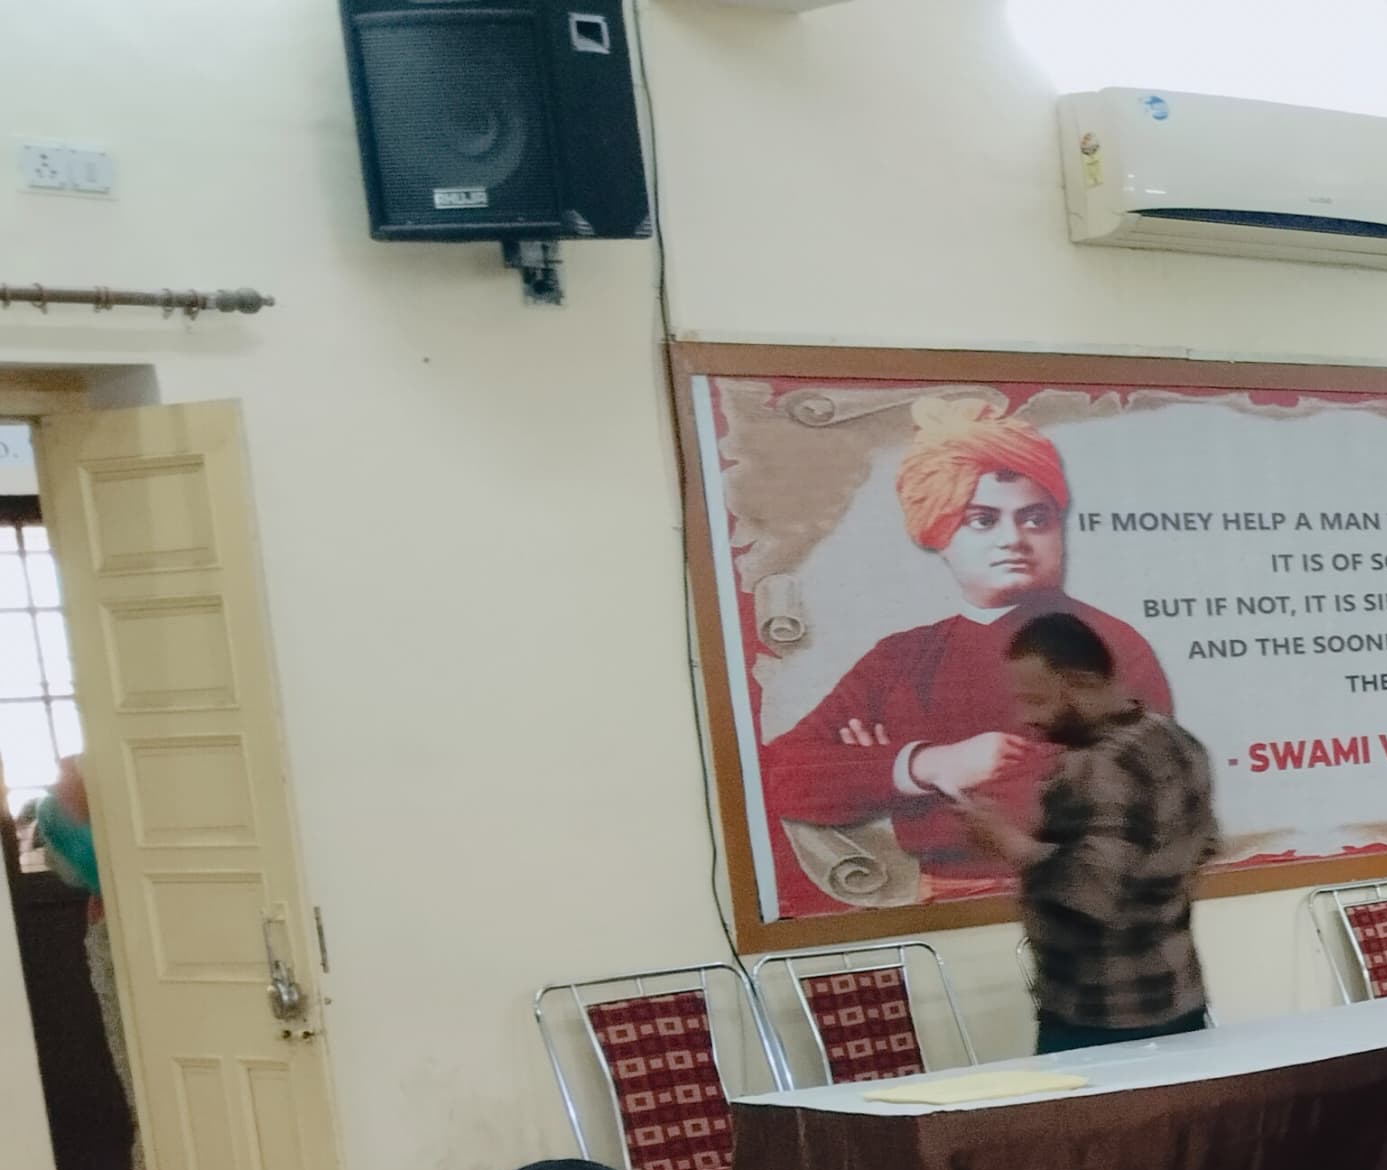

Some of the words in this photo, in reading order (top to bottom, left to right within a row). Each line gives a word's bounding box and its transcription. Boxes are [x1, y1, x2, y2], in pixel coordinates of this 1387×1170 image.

[1078, 512, 1102, 532] IF
[1111, 511, 1213, 532] MONEY
[1222, 512, 1286, 531] HELP
[1294, 511, 1313, 531] A
[1320, 511, 1381, 531] MAN
[1271, 553, 1294, 572] IT
[1302, 553, 1325, 572] IS
[1331, 552, 1363, 572] OF
[1143, 598, 1197, 618] BUT
[1205, 597, 1228, 617] IF
[1235, 596, 1297, 617] NOT,
[1304, 595, 1327, 614] IT
[1334, 594, 1357, 613] IS
[1188, 638, 1249, 660] AND
[1255, 636, 1306, 657] THE
[1248, 734, 1372, 773] SWAMI
